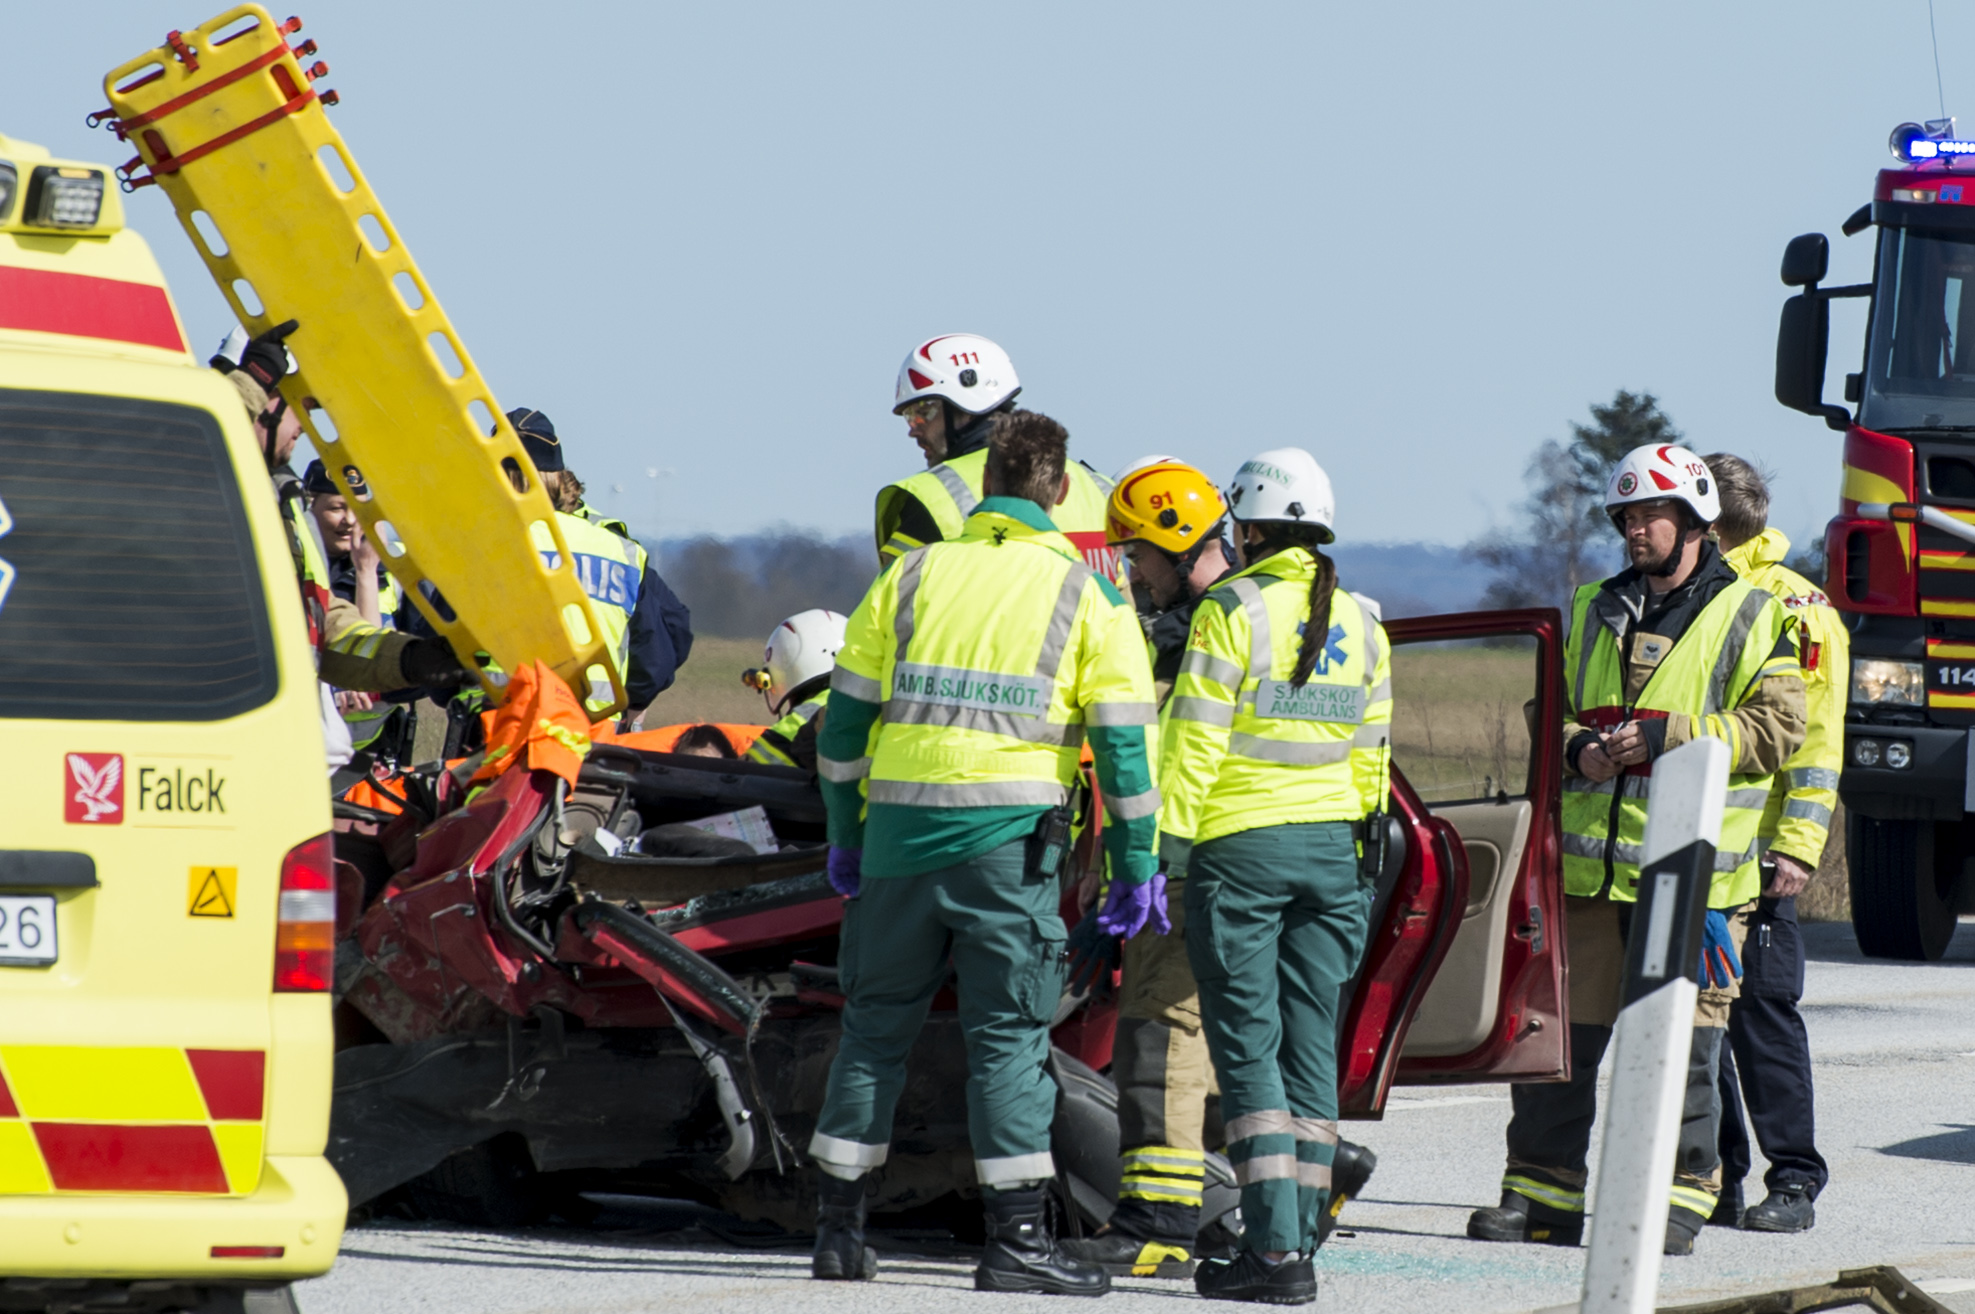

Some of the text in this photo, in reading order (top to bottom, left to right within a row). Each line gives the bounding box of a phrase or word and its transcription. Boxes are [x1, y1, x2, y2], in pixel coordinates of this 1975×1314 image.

[949, 352, 979, 366] 111
[1684, 463, 1707, 476] 101
[1149, 491, 1173, 509] 91
[539, 553, 626, 604] LIS
[1939, 666, 1975, 686] 114
[1274, 685, 1358, 704] SJUKSKÖT
[1270, 701, 1357, 719] AMBULANS
[139, 767, 226, 813] Falck
